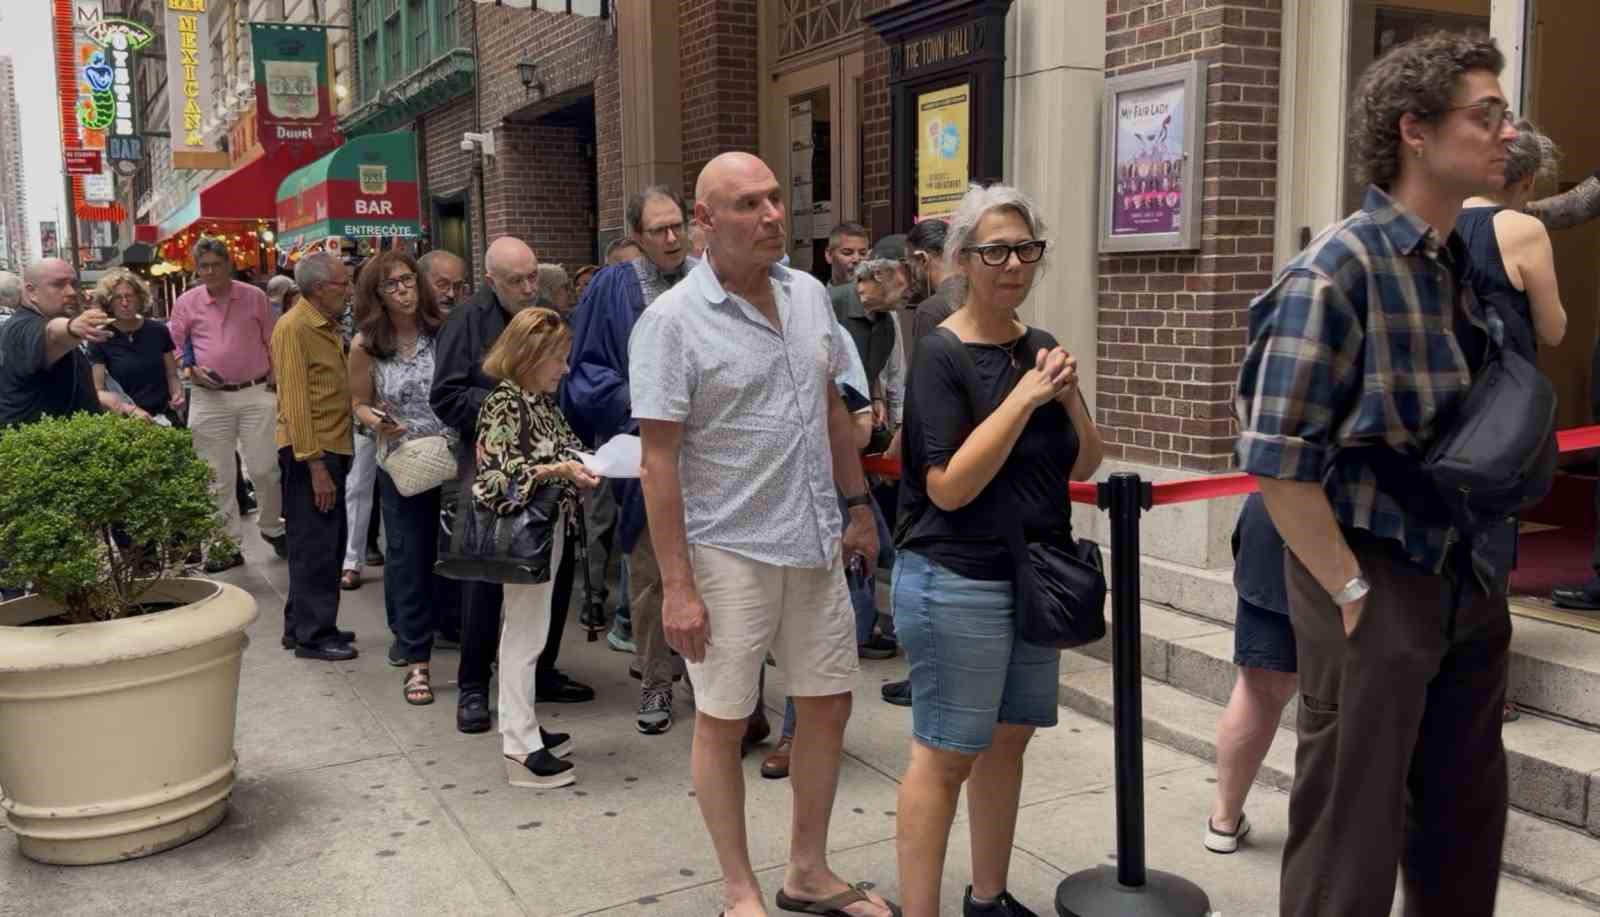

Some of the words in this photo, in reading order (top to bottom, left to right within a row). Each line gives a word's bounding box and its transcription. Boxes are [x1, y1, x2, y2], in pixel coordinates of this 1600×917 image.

[905, 42, 920, 70] THE
[922, 32, 945, 65] TOWN
[948, 26, 970, 58] HALL
[276, 126, 313, 140] Duvel
[354, 199, 394, 215] BAR
